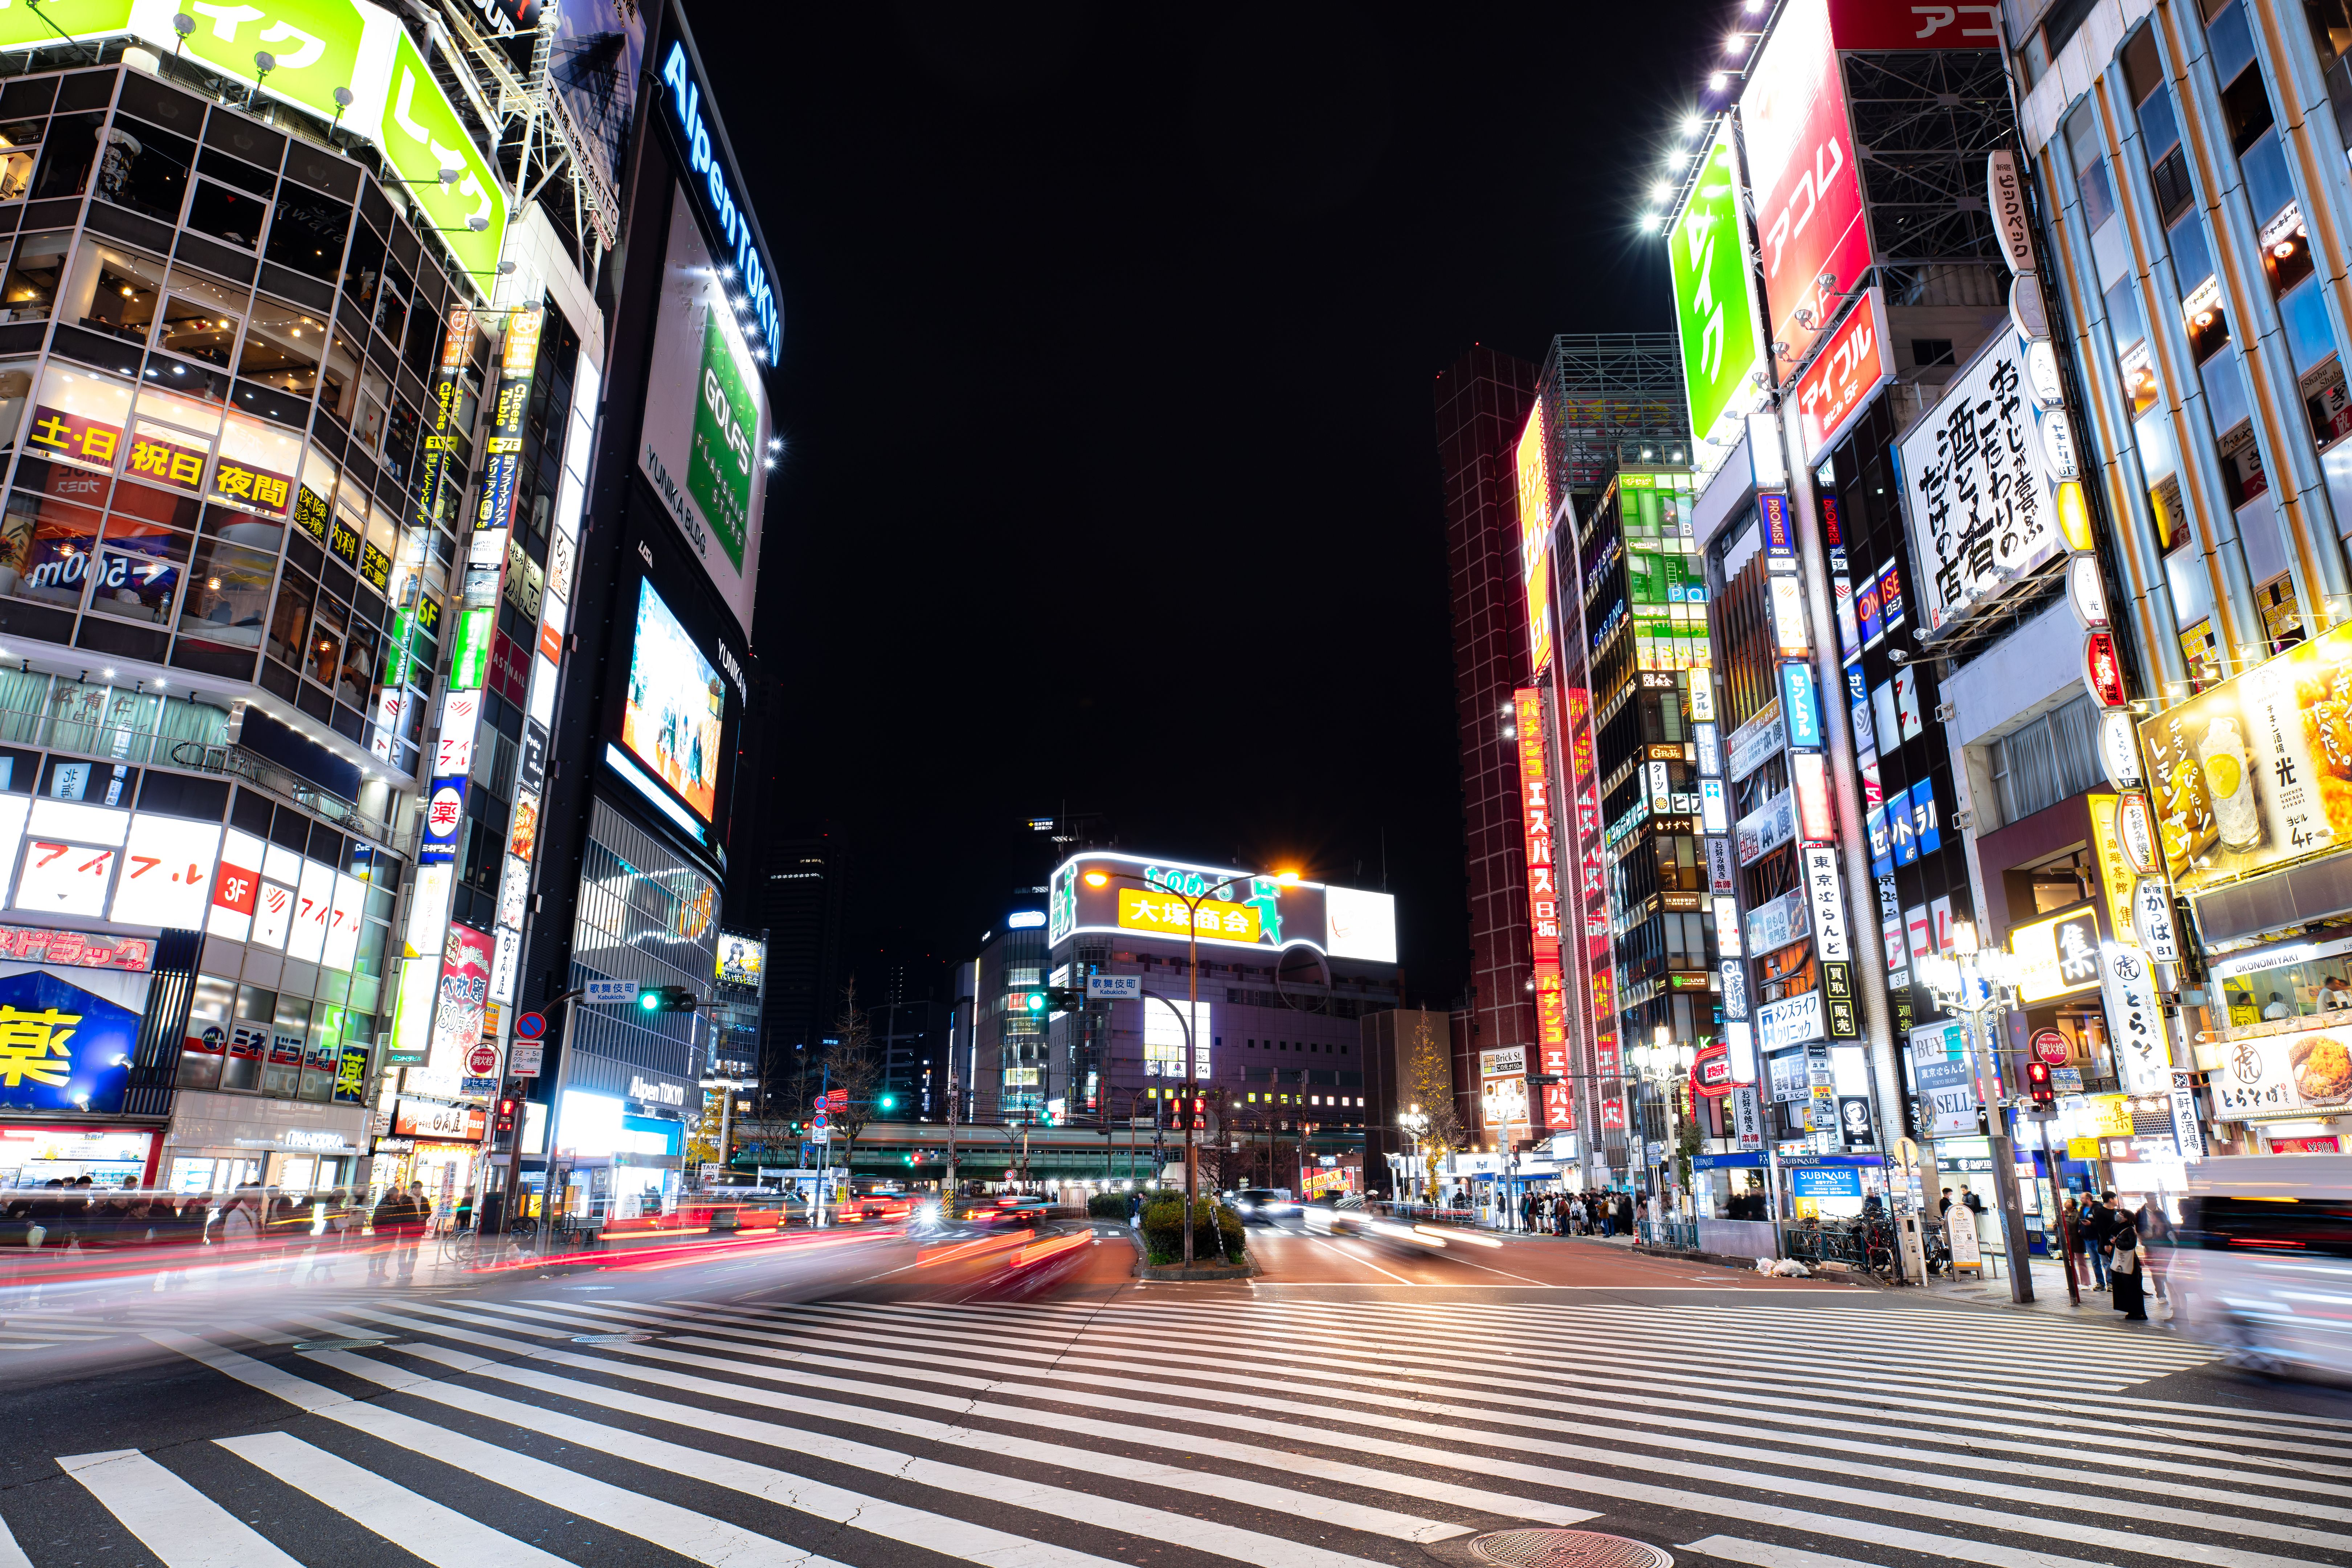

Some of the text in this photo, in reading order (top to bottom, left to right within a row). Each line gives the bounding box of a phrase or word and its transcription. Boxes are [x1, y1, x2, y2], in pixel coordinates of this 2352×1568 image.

[547, 79, 618, 225] 不動産は株式会社TFC
[1996, 163, 2011, 172] 新宿
[664, 40, 780, 367] Alpen TOKYO
[1767, 136, 1843, 279] アコム
[1801, 322, 1871, 422] アイフル
[2303, 368, 2328, 388] Shabu
[2320, 368, 2344, 388] Shabu
[497, 389, 513, 427] Table
[508, 384, 527, 432] Cheese
[1823, 379, 1858, 430] 当ビル 5F
[705, 368, 748, 475] GOLF5
[502, 440, 519, 450] 7F
[1989, 356, 2043, 546] おやじが喜ぶ
[31, 416, 289, 508] 土・日 祝日 夜間
[2059, 465, 2075, 475] 6F
[483, 457, 501, 499] クリニック
[697, 433, 744, 523] FLAGSHIP
[1936, 396, 1995, 583] 酒と肴
[1976, 399, 2018, 559] こだわりの
[299, 485, 328, 523] 保険
[493, 465, 514, 526] プライマリケア
[646, 443, 706, 559] YUNIKA BLDG.
[295, 503, 324, 538] 診療
[713, 490, 742, 546] STORE
[1767, 498, 1785, 545] PROMISE
[332, 523, 356, 561] 内科
[1919, 462, 1963, 613] だけの店
[364, 546, 389, 573] 予約
[1588, 535, 1617, 588] SHISHA
[362, 558, 386, 591] 不要
[418, 597, 438, 628] 6F
[1593, 598, 1624, 648] CASINO
[2180, 619, 2212, 646] 団体様
[2184, 640, 2205, 659] 歓迎
[1695, 692, 1709, 710] ブル
[1790, 673, 1811, 737] セントラル
[527, 734, 541, 751] Rydia
[1523, 699, 1542, 776] パチンコ
[2267, 705, 2285, 754] チキン酒場
[1651, 748, 1681, 759] GROVE
[1747, 737, 1763, 754] お好み焼き
[1652, 763, 1663, 791] ダーツ
[2122, 778, 2136, 787] 1F
[2275, 757, 2298, 787] 光
[2150, 737, 2198, 874] レモンサワー
[2279, 787, 2303, 798] CHICKEN
[2281, 793, 2304, 804] SAKABA
[2282, 799, 2305, 809] HIKARI
[430, 801, 459, 824] 薬
[2286, 813, 2308, 827] 当ビル
[1761, 805, 1791, 849] 本陣
[2129, 808, 2150, 865] お好み焼き
[2291, 828, 2313, 849] 4F
[35, 842, 203, 885] アイフル
[1715, 841, 1726, 879] お好み焼き
[1905, 849, 1914, 860] 4F
[225, 877, 249, 903] 3F
[1145, 866, 1233, 901] たのめーる
[1130, 899, 1249, 934] 大塚商会
[1813, 856, 1840, 955] 東京ぶらんど
[2145, 895, 2171, 941] かっぱ
[1766, 911, 1784, 931] 粉もの
[1767, 927, 1788, 946] 専門店
[2157, 946, 2172, 955] B1
[2235, 954, 2299, 973] OKONOMIYAKI
[589, 983, 634, 993] 歌舞伎町
[721, 971, 759, 985] たいせい先生
[1092, 978, 1136, 989] 歌舞伎町
[1830, 968, 1846, 994] 買取
[1896, 974, 1905, 985] 3F
[1543, 975, 1562, 1042] パチンコ
[1736, 981, 1748, 1018] スパークル
[1773, 996, 1817, 1023] メンズライフ
[2144, 995, 2152, 1016] TORA
[1776, 1020, 1811, 1044] クリニック
[1834, 1005, 1851, 1033] 販売
[472, 1055, 494, 1066] 消火栓
[1496, 1052, 1522, 1063] Brick St.
[1915, 1035, 1943, 1058] BUY
[2039, 1043, 2065, 1055] 消火栓
[2113, 1034, 2124, 1073] とらそば
[1775, 1077, 1789, 1091] 酒場
[1921, 1062, 1965, 1079] 東京ぶらんど
[630, 1076, 683, 1106] Alpen TOKYO
[1936, 1091, 1972, 1114] SELL
[2222, 1083, 2279, 1108] とらそば
[2176, 1091, 2199, 1150] 一軒め酒場
[2307, 1142, 2335, 1153] ¥300
[1695, 1157, 1714, 1167] SUBNADE
[1800, 1171, 1852, 1180] SUBNADE
[1305, 1172, 1338, 1188] CLIMAX
